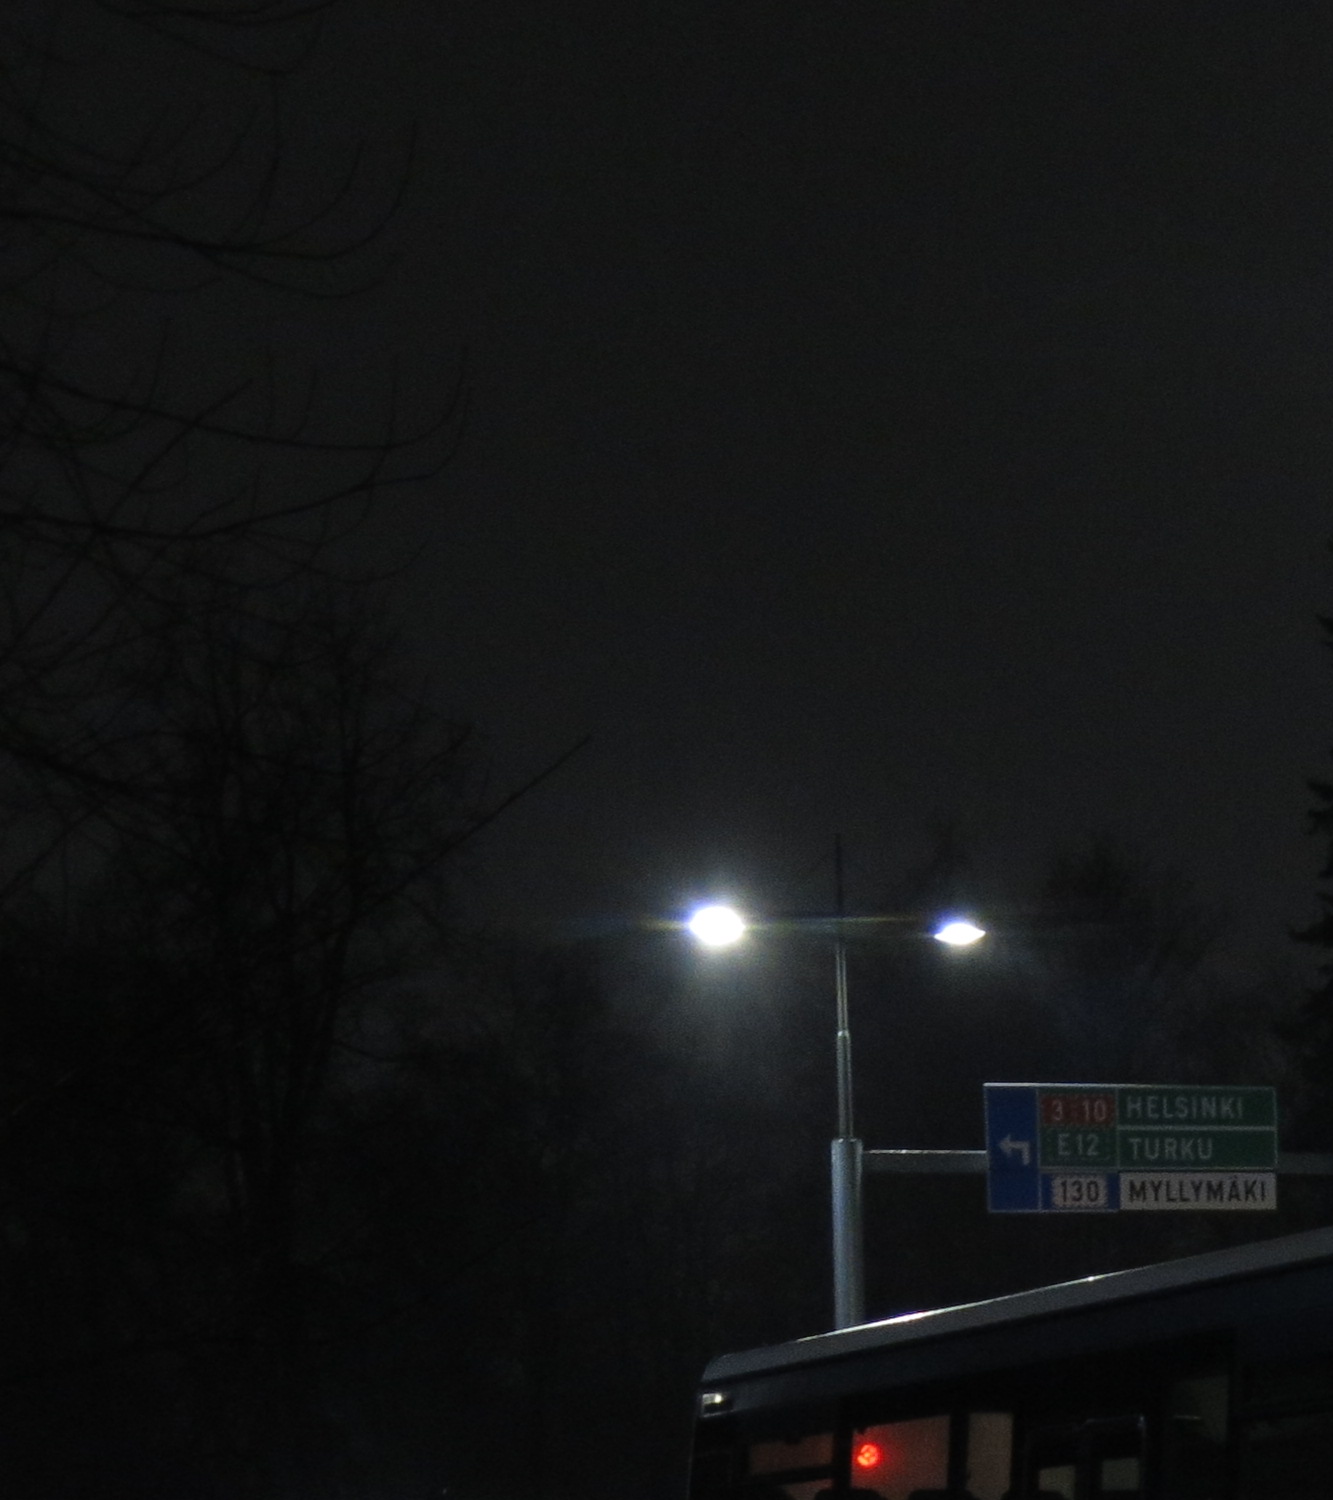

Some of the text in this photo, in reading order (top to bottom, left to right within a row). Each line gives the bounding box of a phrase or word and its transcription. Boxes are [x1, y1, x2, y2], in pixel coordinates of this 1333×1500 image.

[1052, 1099, 1064, 1121] 3
[1082, 1098, 1107, 1121] 10
[1126, 1095, 1244, 1119] HELSINKI
[1057, 1132, 1100, 1156] E12
[1128, 1137, 1213, 1160] TURKU
[1060, 1179, 1100, 1202] 130
[1128, 1174, 1267, 1202] MYLLYMÄKI
